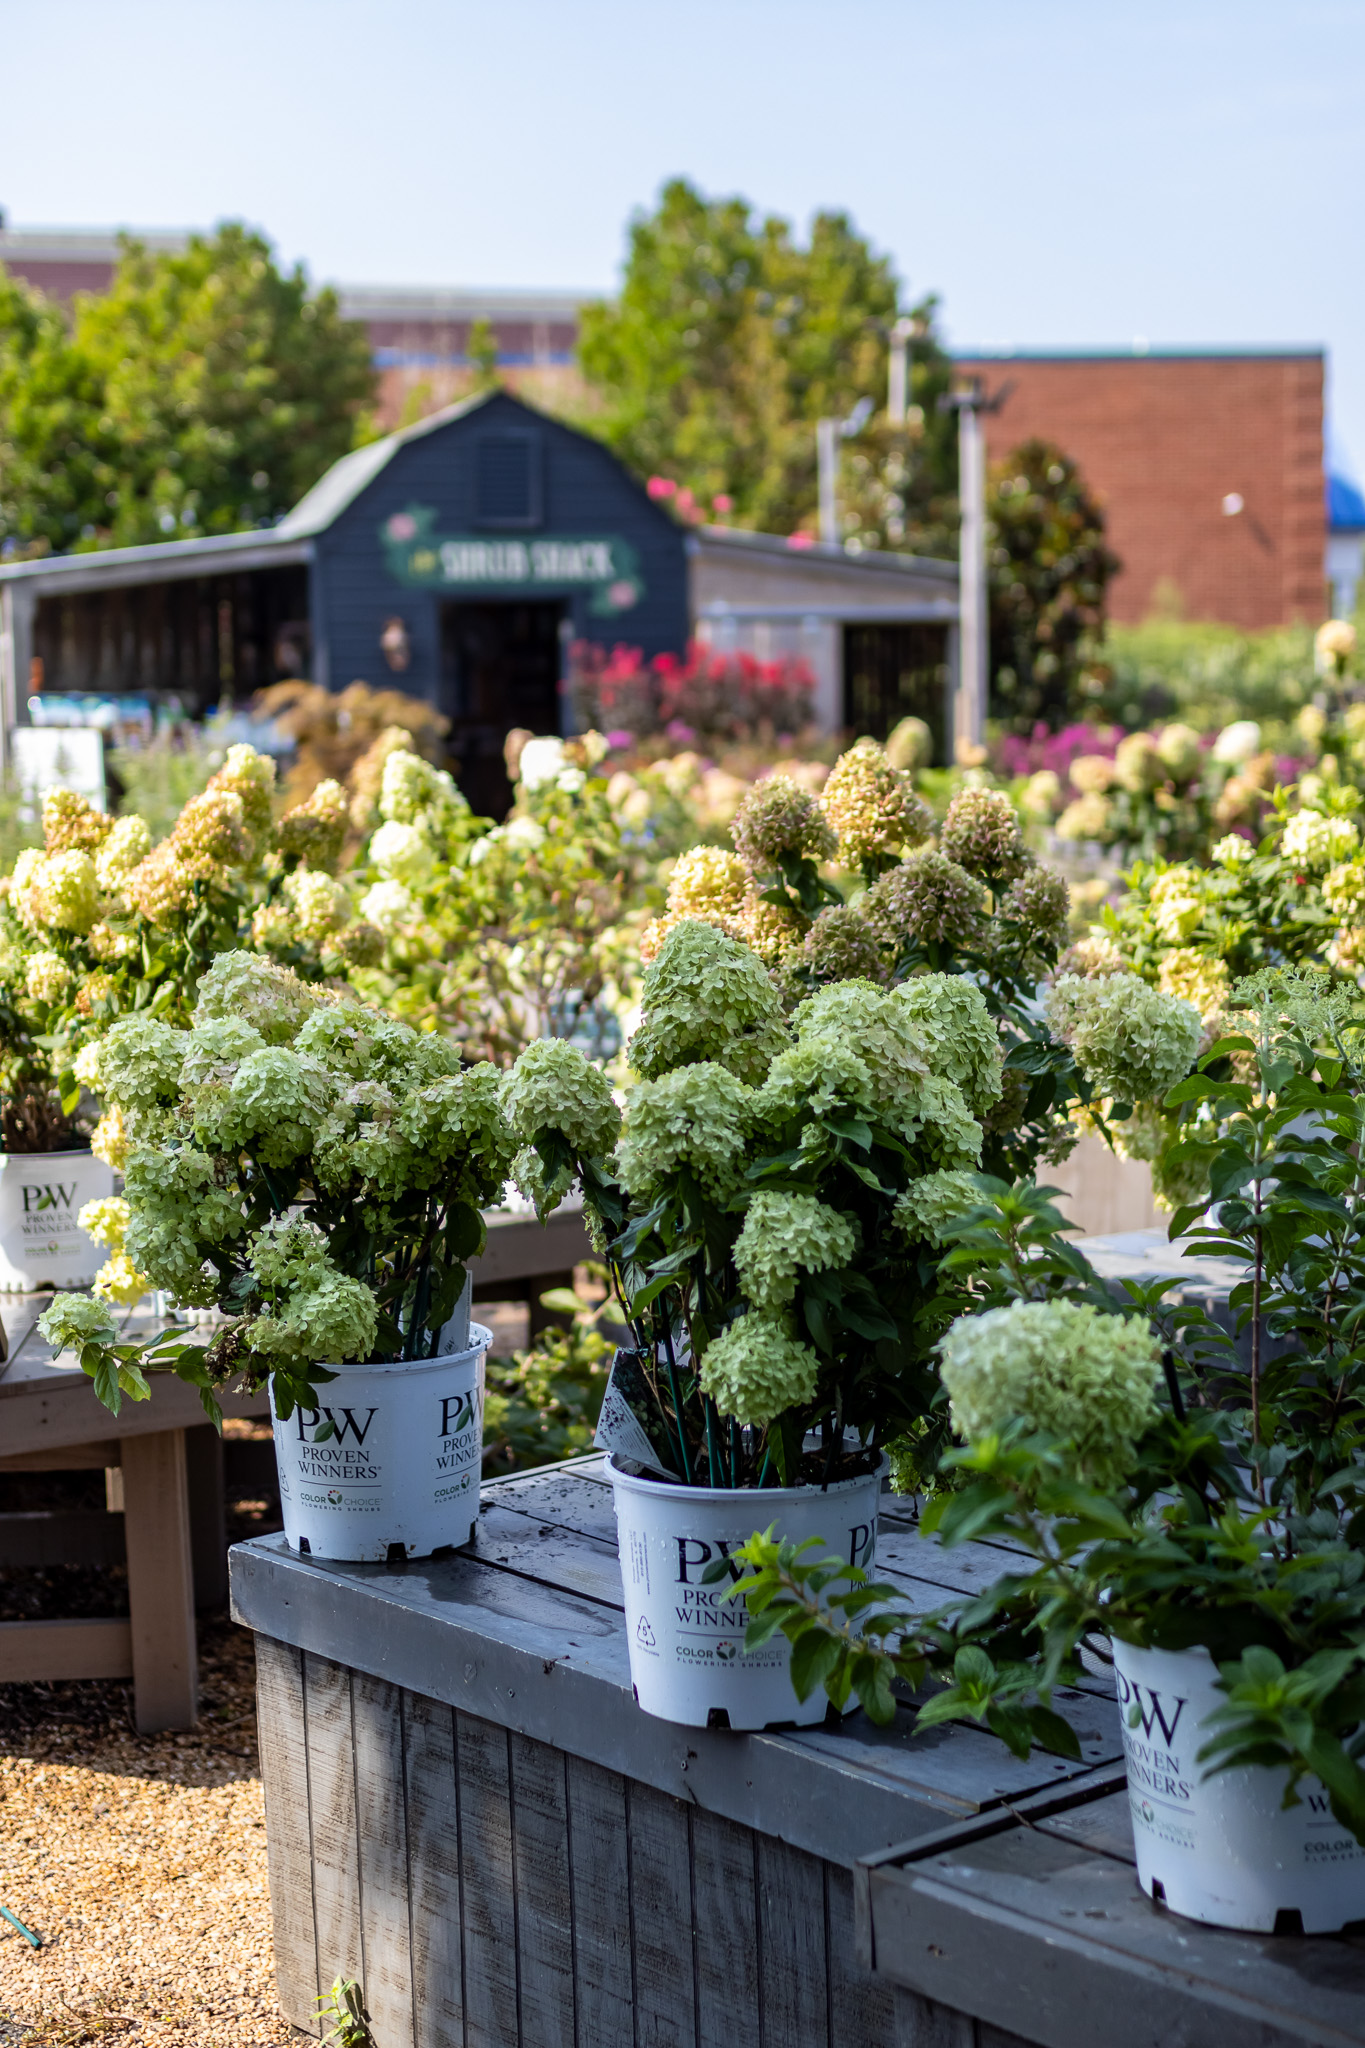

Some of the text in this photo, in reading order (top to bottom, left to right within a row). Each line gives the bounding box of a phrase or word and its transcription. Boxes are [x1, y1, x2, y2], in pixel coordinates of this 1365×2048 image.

[20, 1182, 77, 1212] PW
[26, 1212, 73, 1224] PROVEN
[21, 1222, 78, 1236] WINNERS
[296, 1403, 380, 1447] PW
[302, 1446, 370, 1463] PROVEN
[300, 1492, 326, 1504] COLOR
[434, 1484, 460, 1498] COLOR
[301, 1501, 342, 1512] FLOWERING
[676, 1646, 783, 1661] COLOR CHOICE
[676, 1656, 735, 1668] FLOWERING
[1304, 1840, 1353, 1854] COLOR
